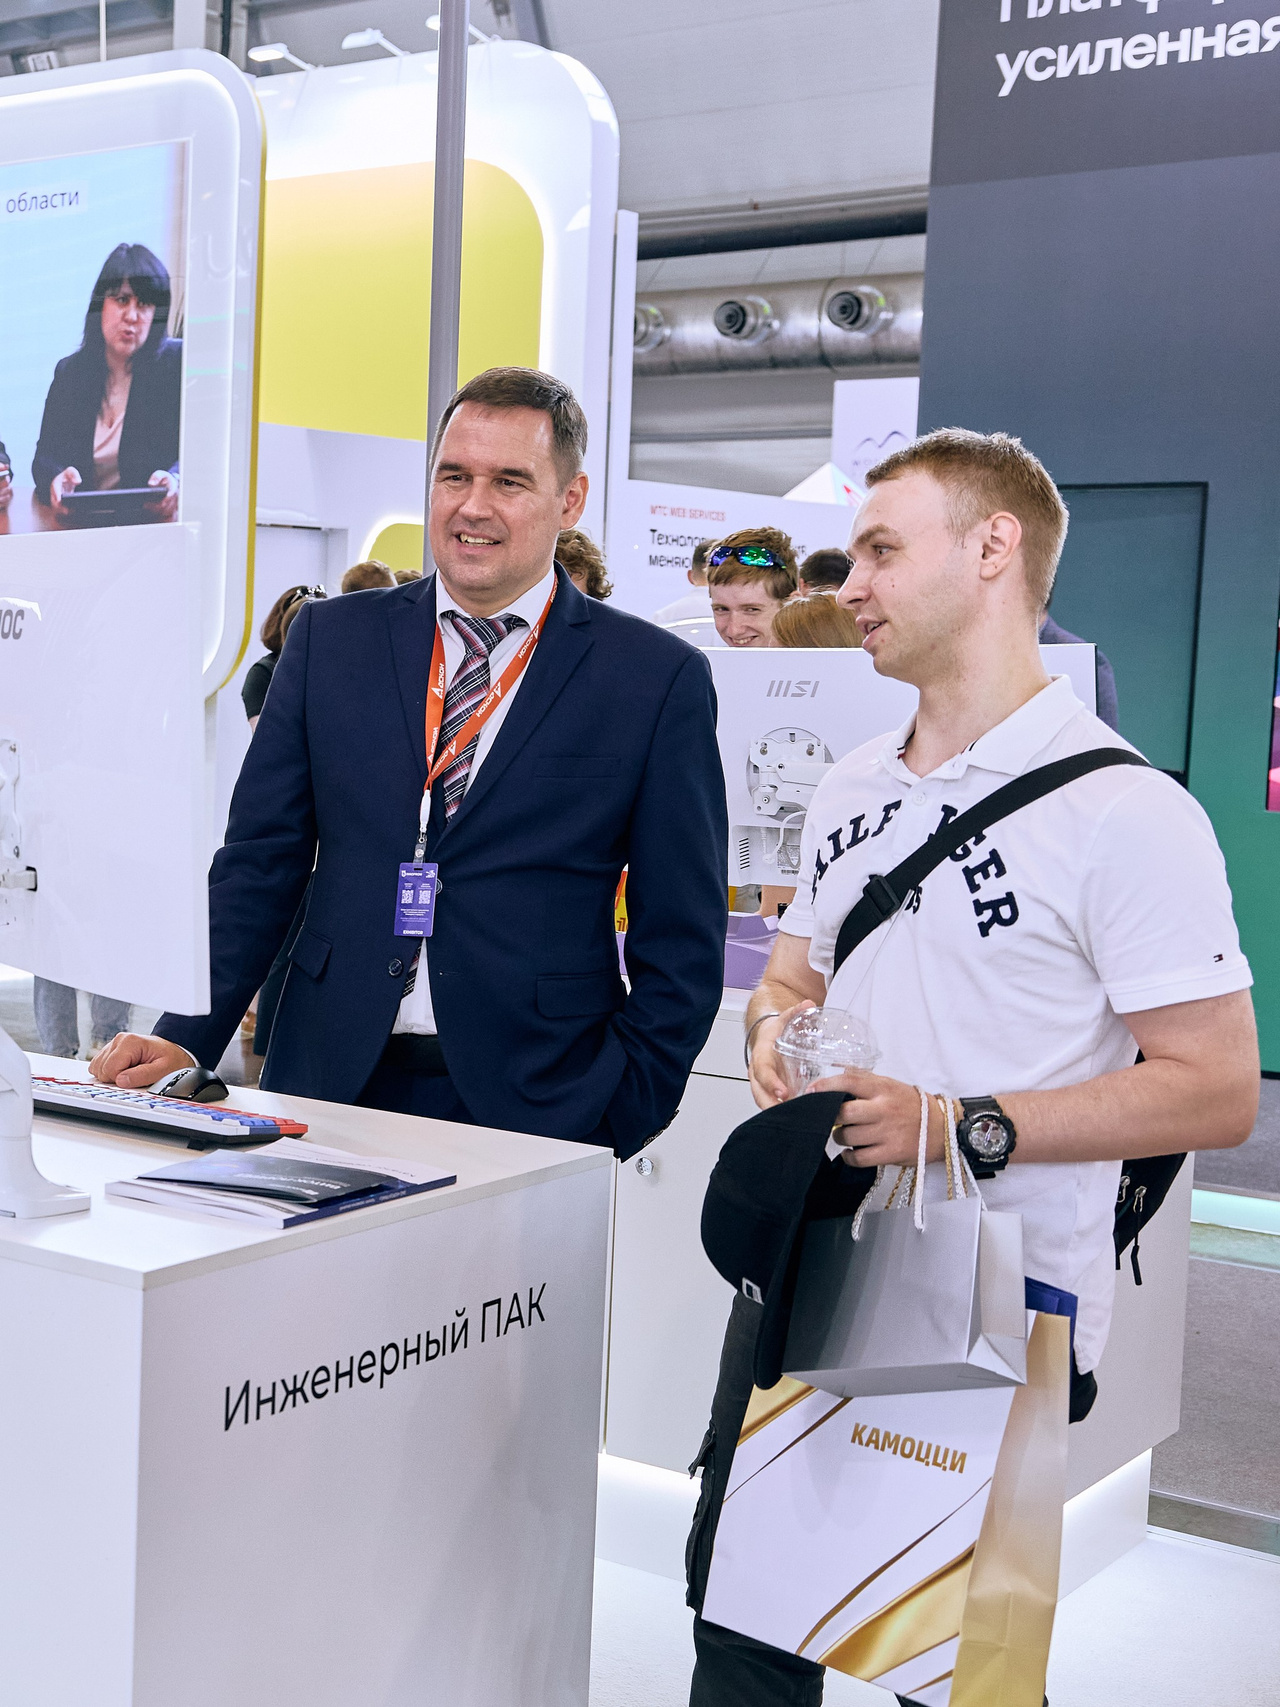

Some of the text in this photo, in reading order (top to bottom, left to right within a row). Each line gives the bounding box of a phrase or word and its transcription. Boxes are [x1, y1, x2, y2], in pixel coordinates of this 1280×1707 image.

[995, 16, 1280, 97] усиленная
[6, 187, 80, 214] области
[649, 528, 707, 549] Техноло
[648, 554, 692, 568] меняю
[766, 680, 820, 698] MSI
[224, 1282, 548, 1432] Инженерный ПАК
[850, 1422, 968, 1474] КАМОЦЦИ
